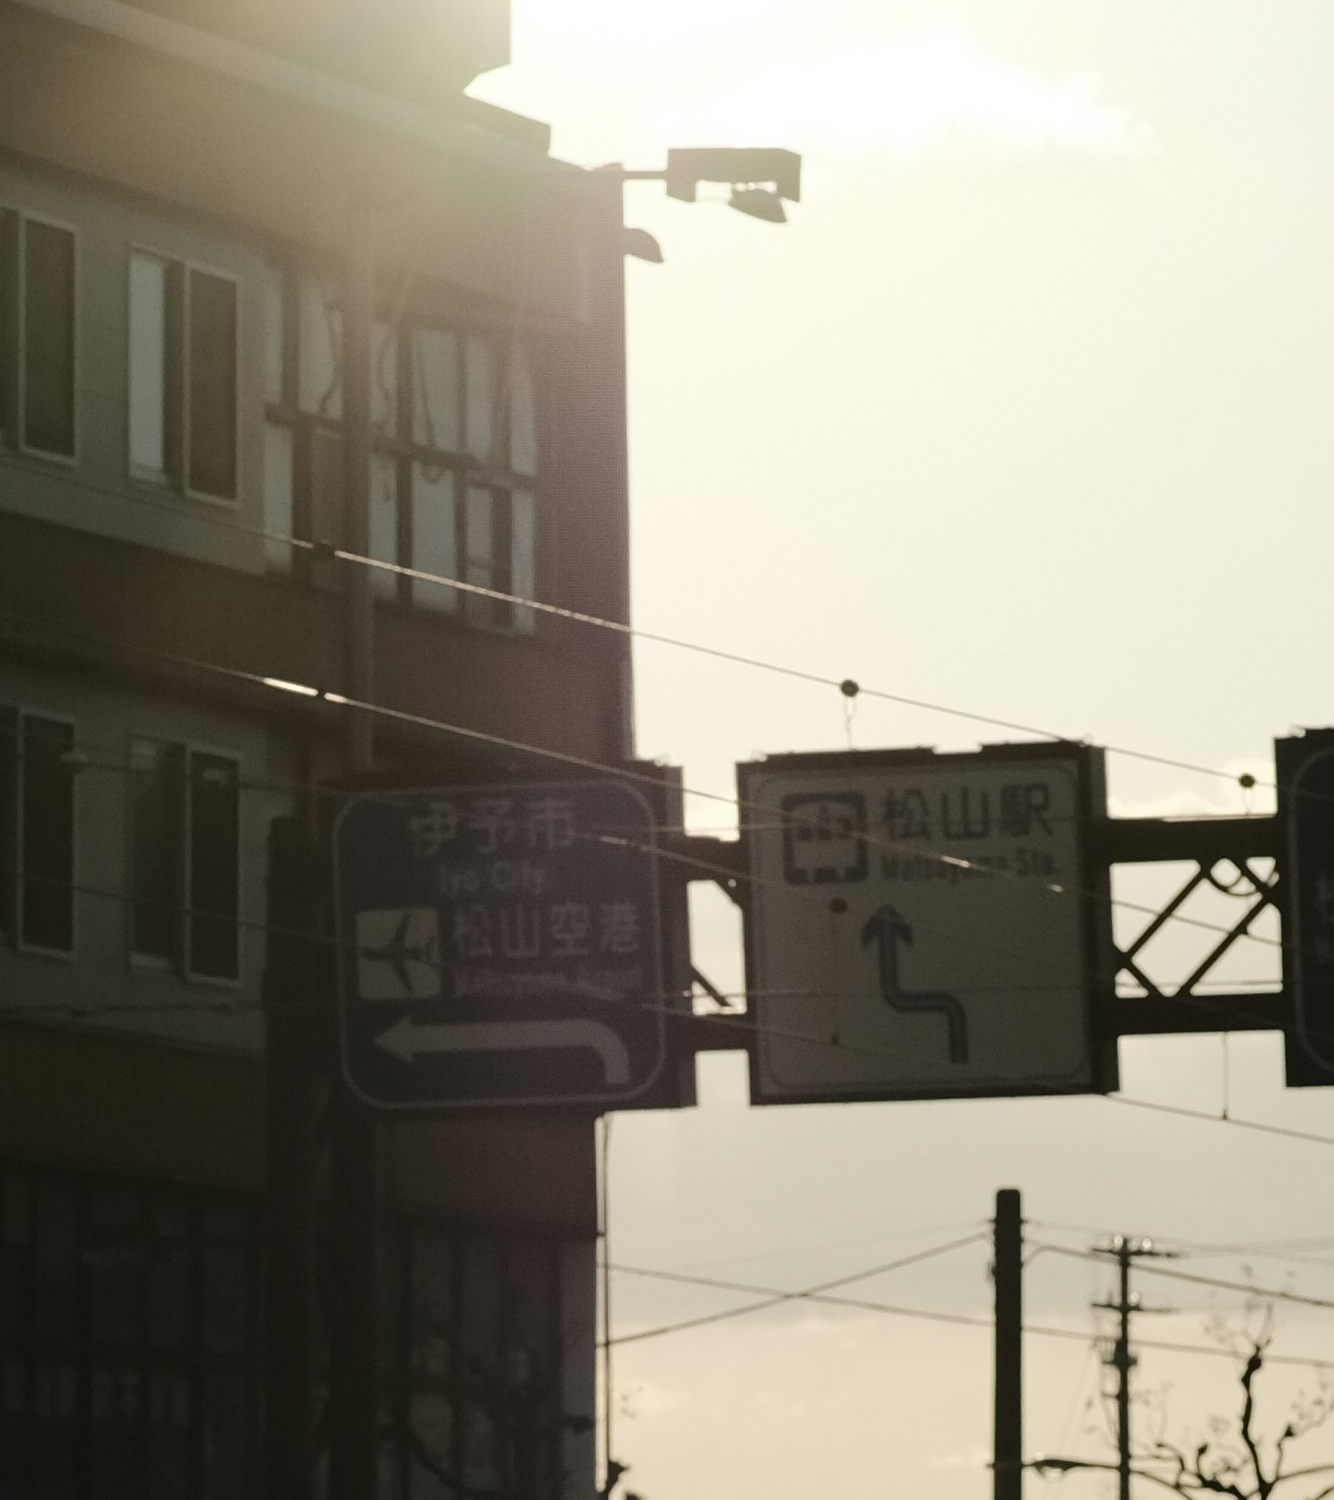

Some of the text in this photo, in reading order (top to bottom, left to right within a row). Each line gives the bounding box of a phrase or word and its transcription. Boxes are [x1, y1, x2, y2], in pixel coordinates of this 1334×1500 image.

[408, 798, 575, 856] 伊予市
[883, 782, 1053, 841] 松山駅
[454, 902, 640, 958] 松山空港
